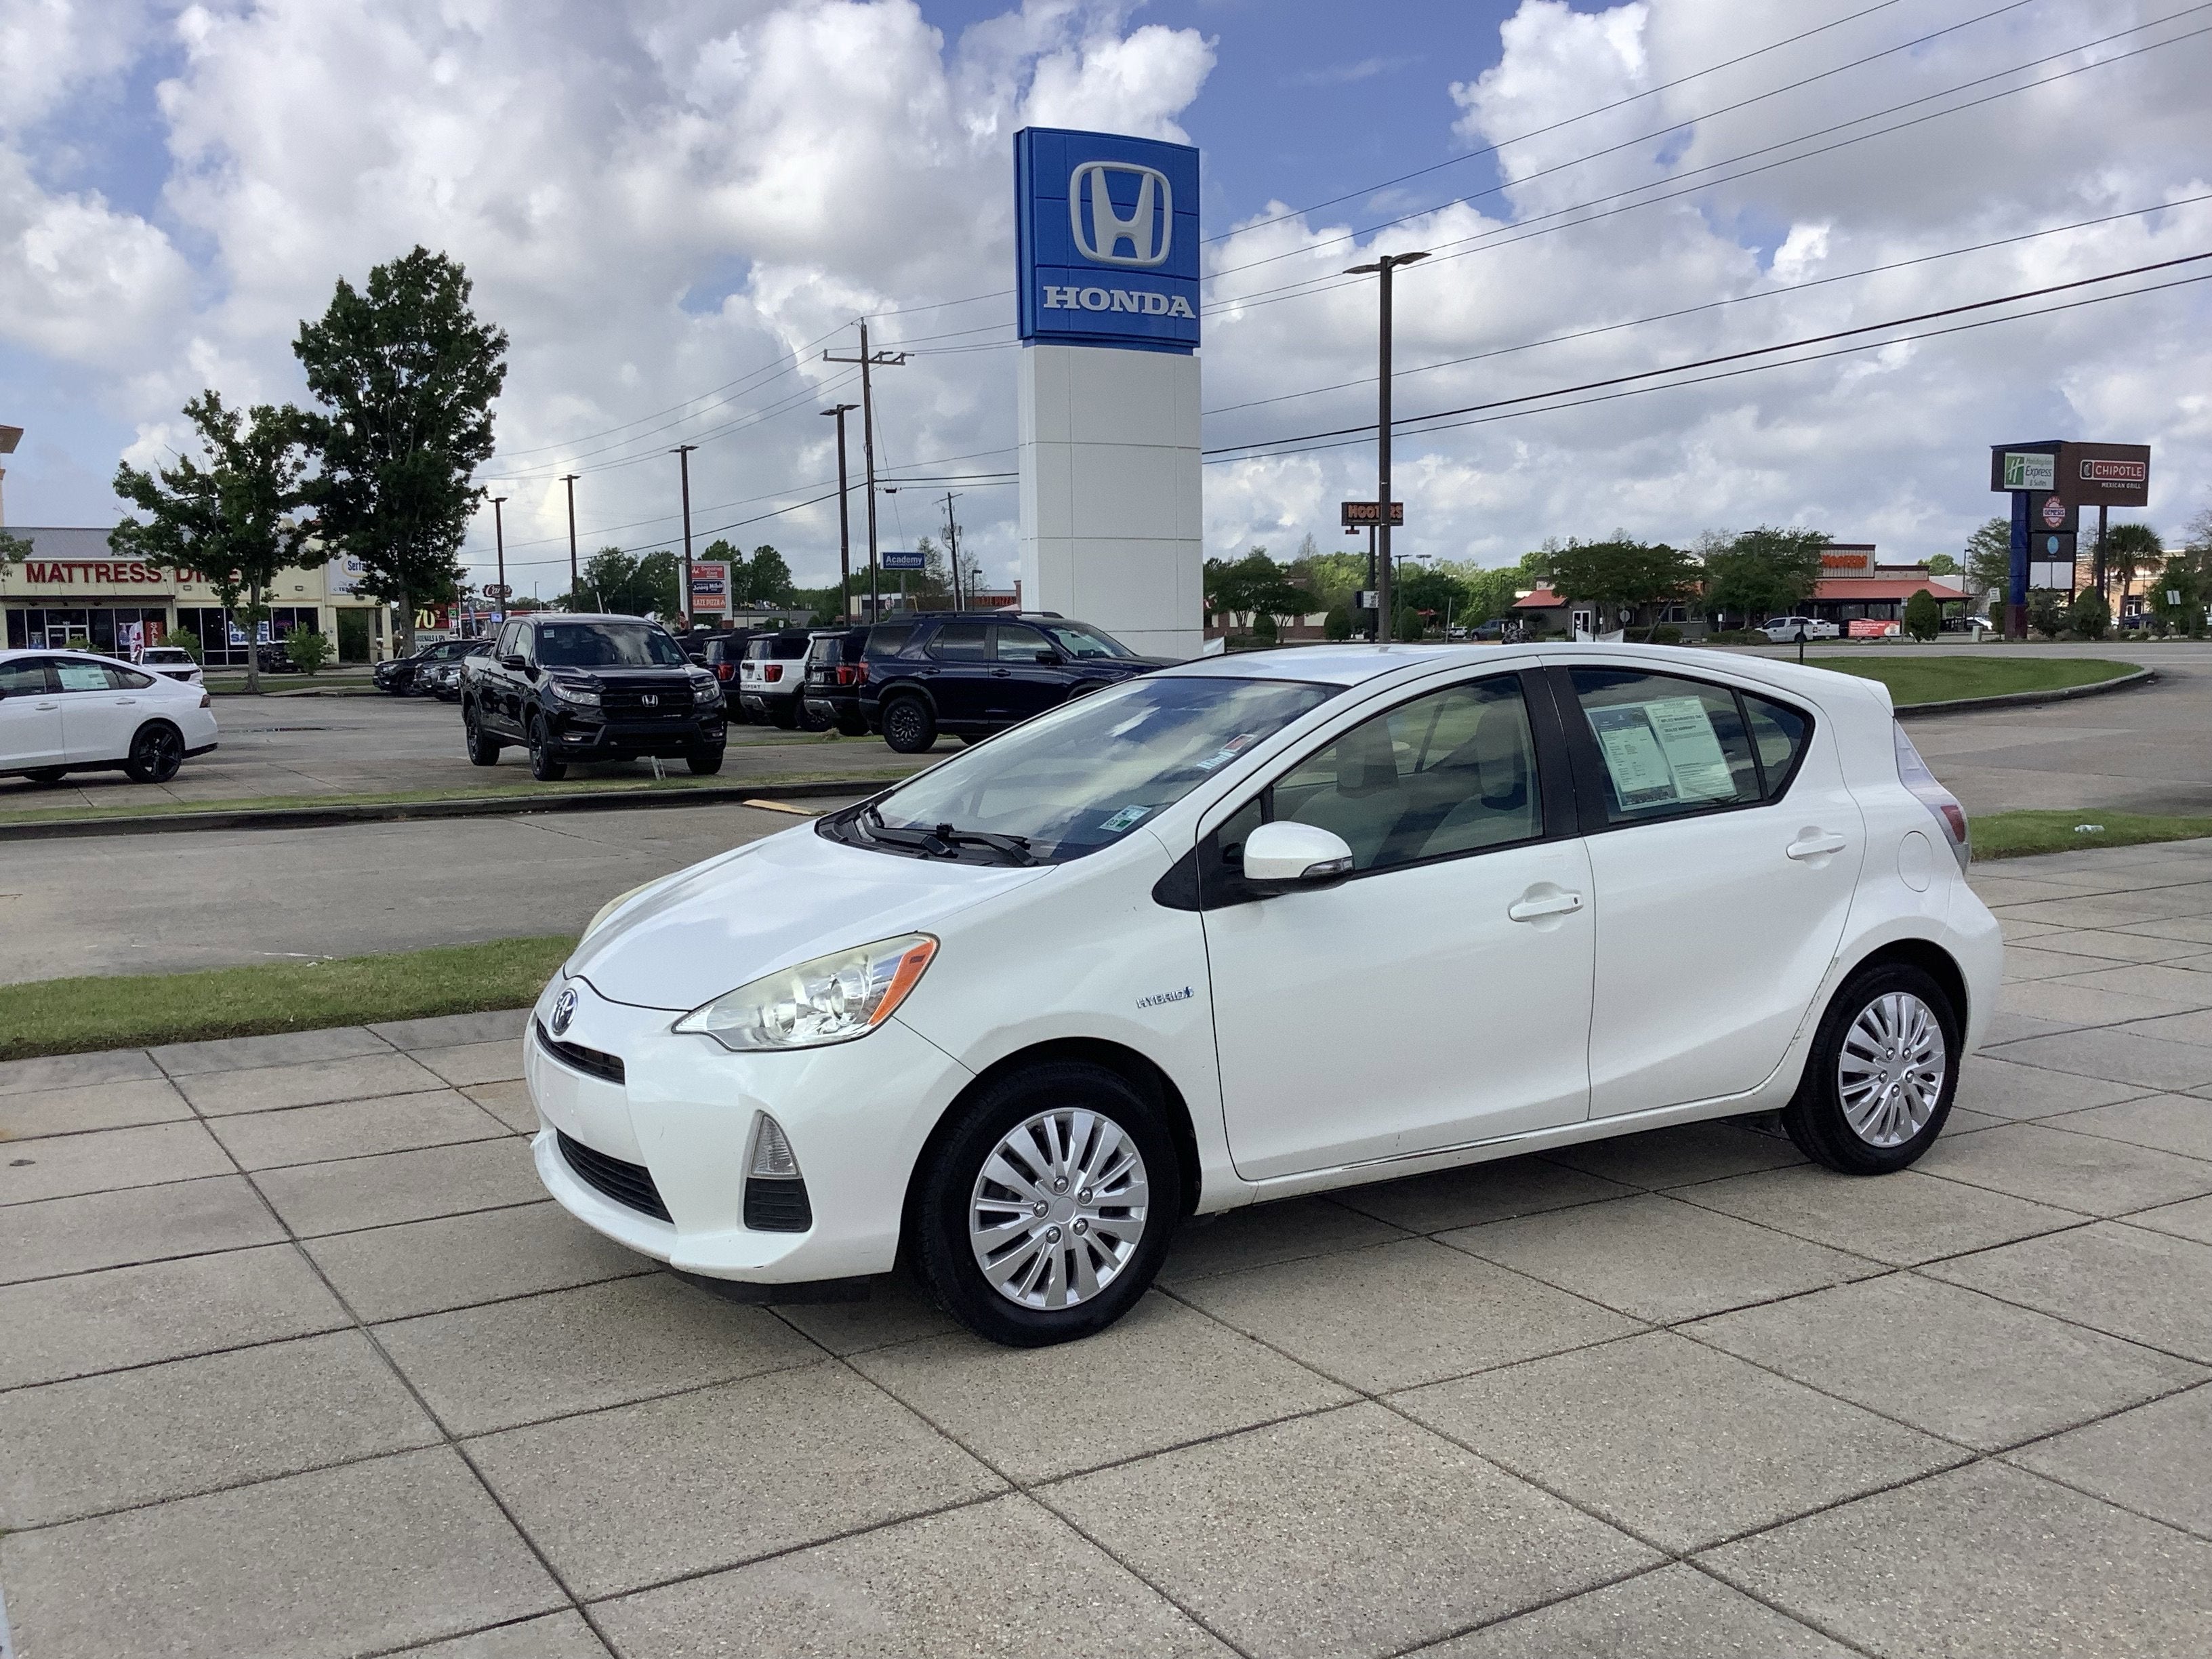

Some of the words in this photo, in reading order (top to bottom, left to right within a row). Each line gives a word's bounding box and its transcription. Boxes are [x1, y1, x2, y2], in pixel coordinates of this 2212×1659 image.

[1043, 286, 1196, 319] HONDA
[2026, 465, 2052, 478] Express
[2095, 465, 2143, 477] CHIPOTLE
[1348, 505, 1402, 518] HOOTRS
[886, 555, 922, 565] Academy
[26, 562, 163, 583] MATTRESS
[706, 598, 720, 607] PIZZA
[1136, 990, 1184, 1008] HYBRID
